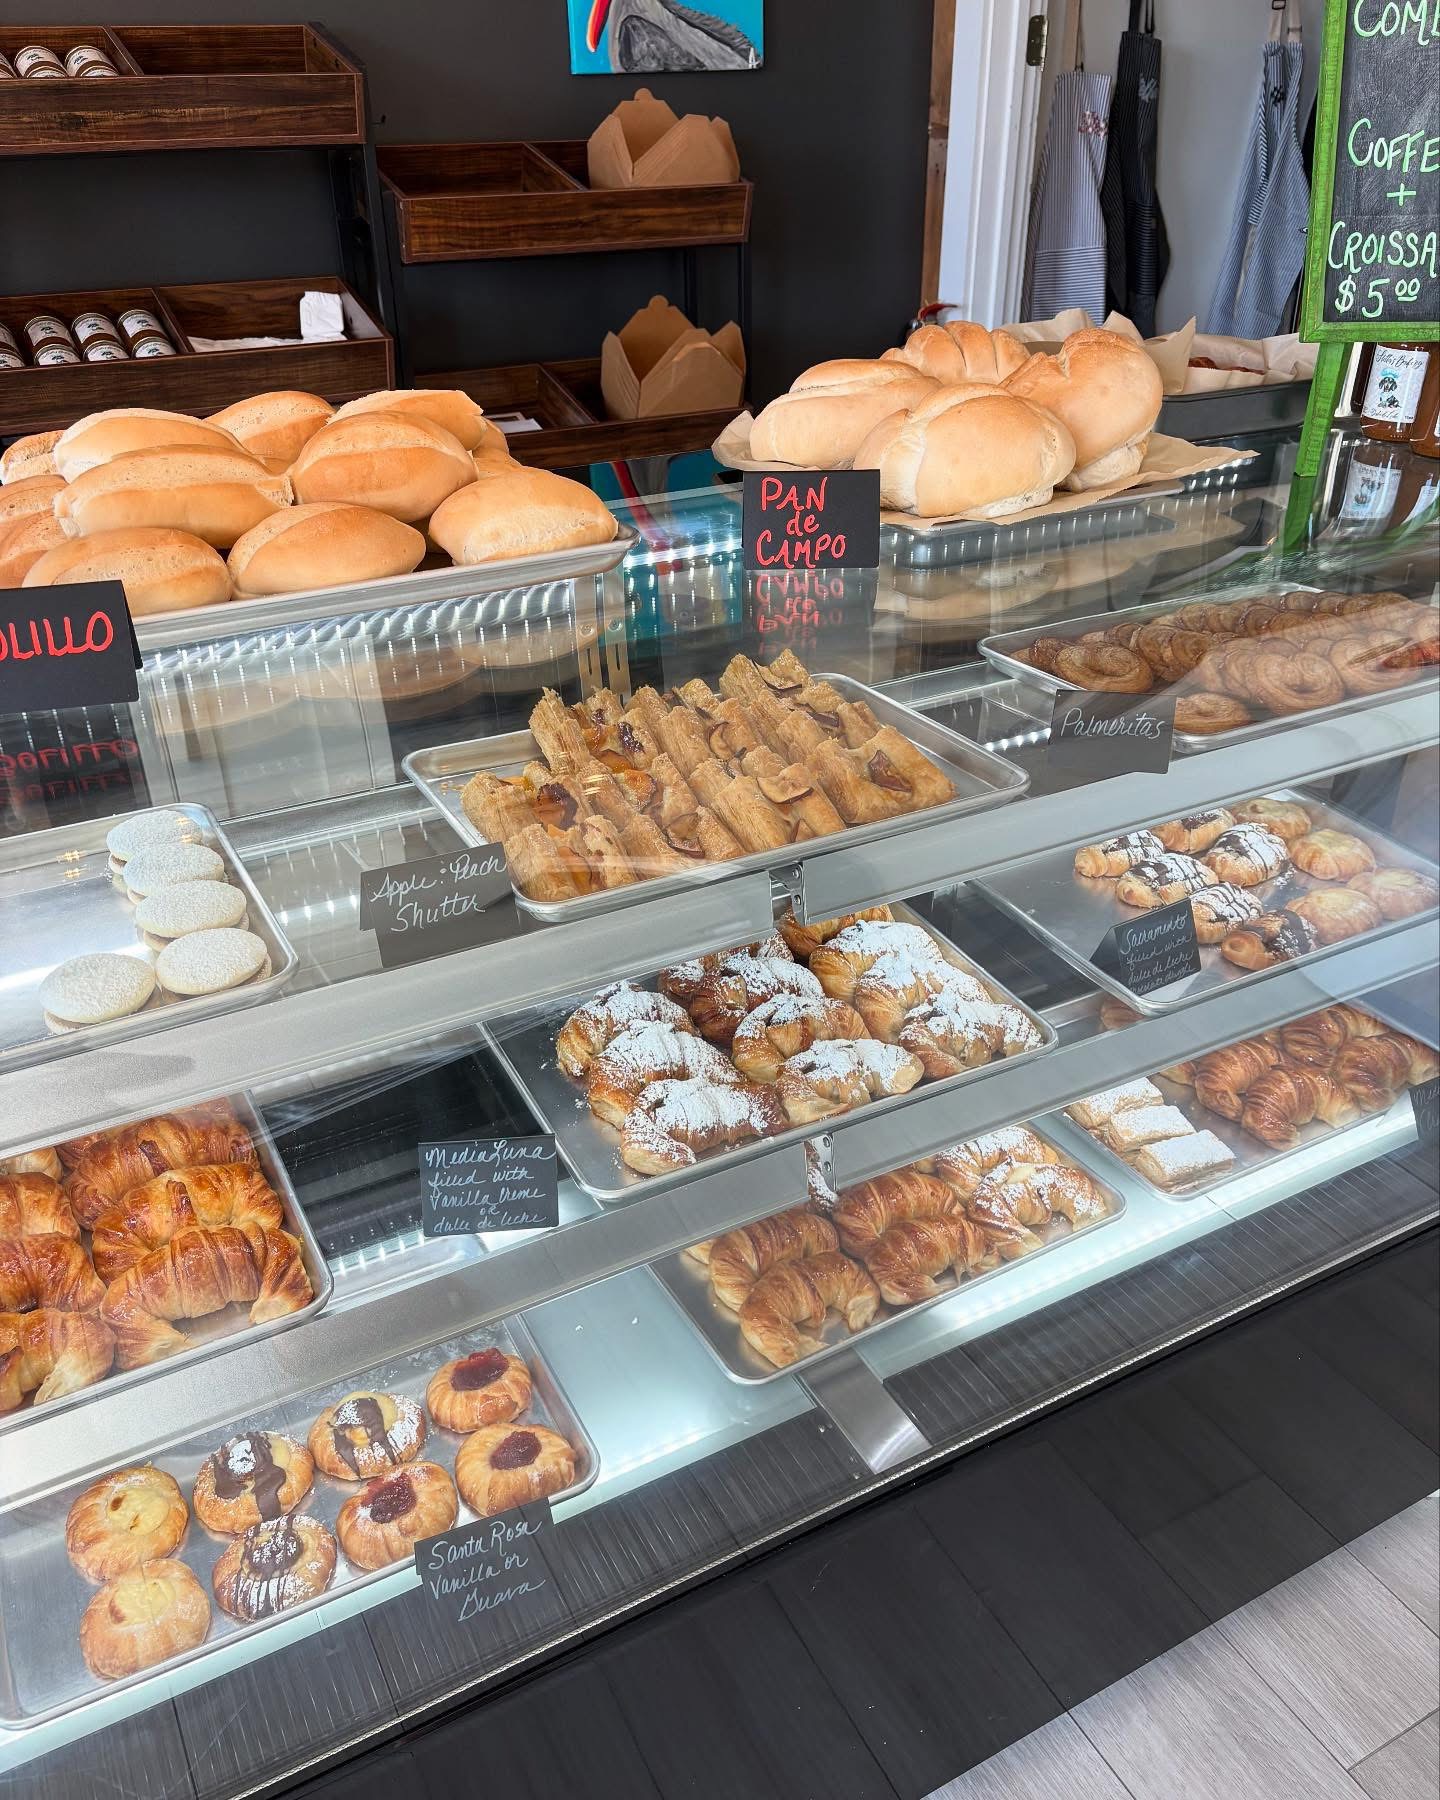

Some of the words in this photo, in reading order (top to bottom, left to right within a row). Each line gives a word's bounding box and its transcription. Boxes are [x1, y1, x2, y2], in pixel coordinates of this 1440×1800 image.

[1327, 220, 1438, 278] CROISSA
[761, 476, 828, 511] PAN
[786, 511, 820, 536] de
[756, 529, 847, 569] CAMPO
[1060, 707, 1166, 739] Palmeritas
[370, 872, 437, 906] Apple
[391, 892, 486, 932] Shutter
[493, 1165, 534, 1182] with
[428, 1536, 489, 1570] Santa
[489, 1520, 543, 1557] Rosa
[430, 1563, 501, 1600] Vanilla
[504, 1552, 529, 1570] or
